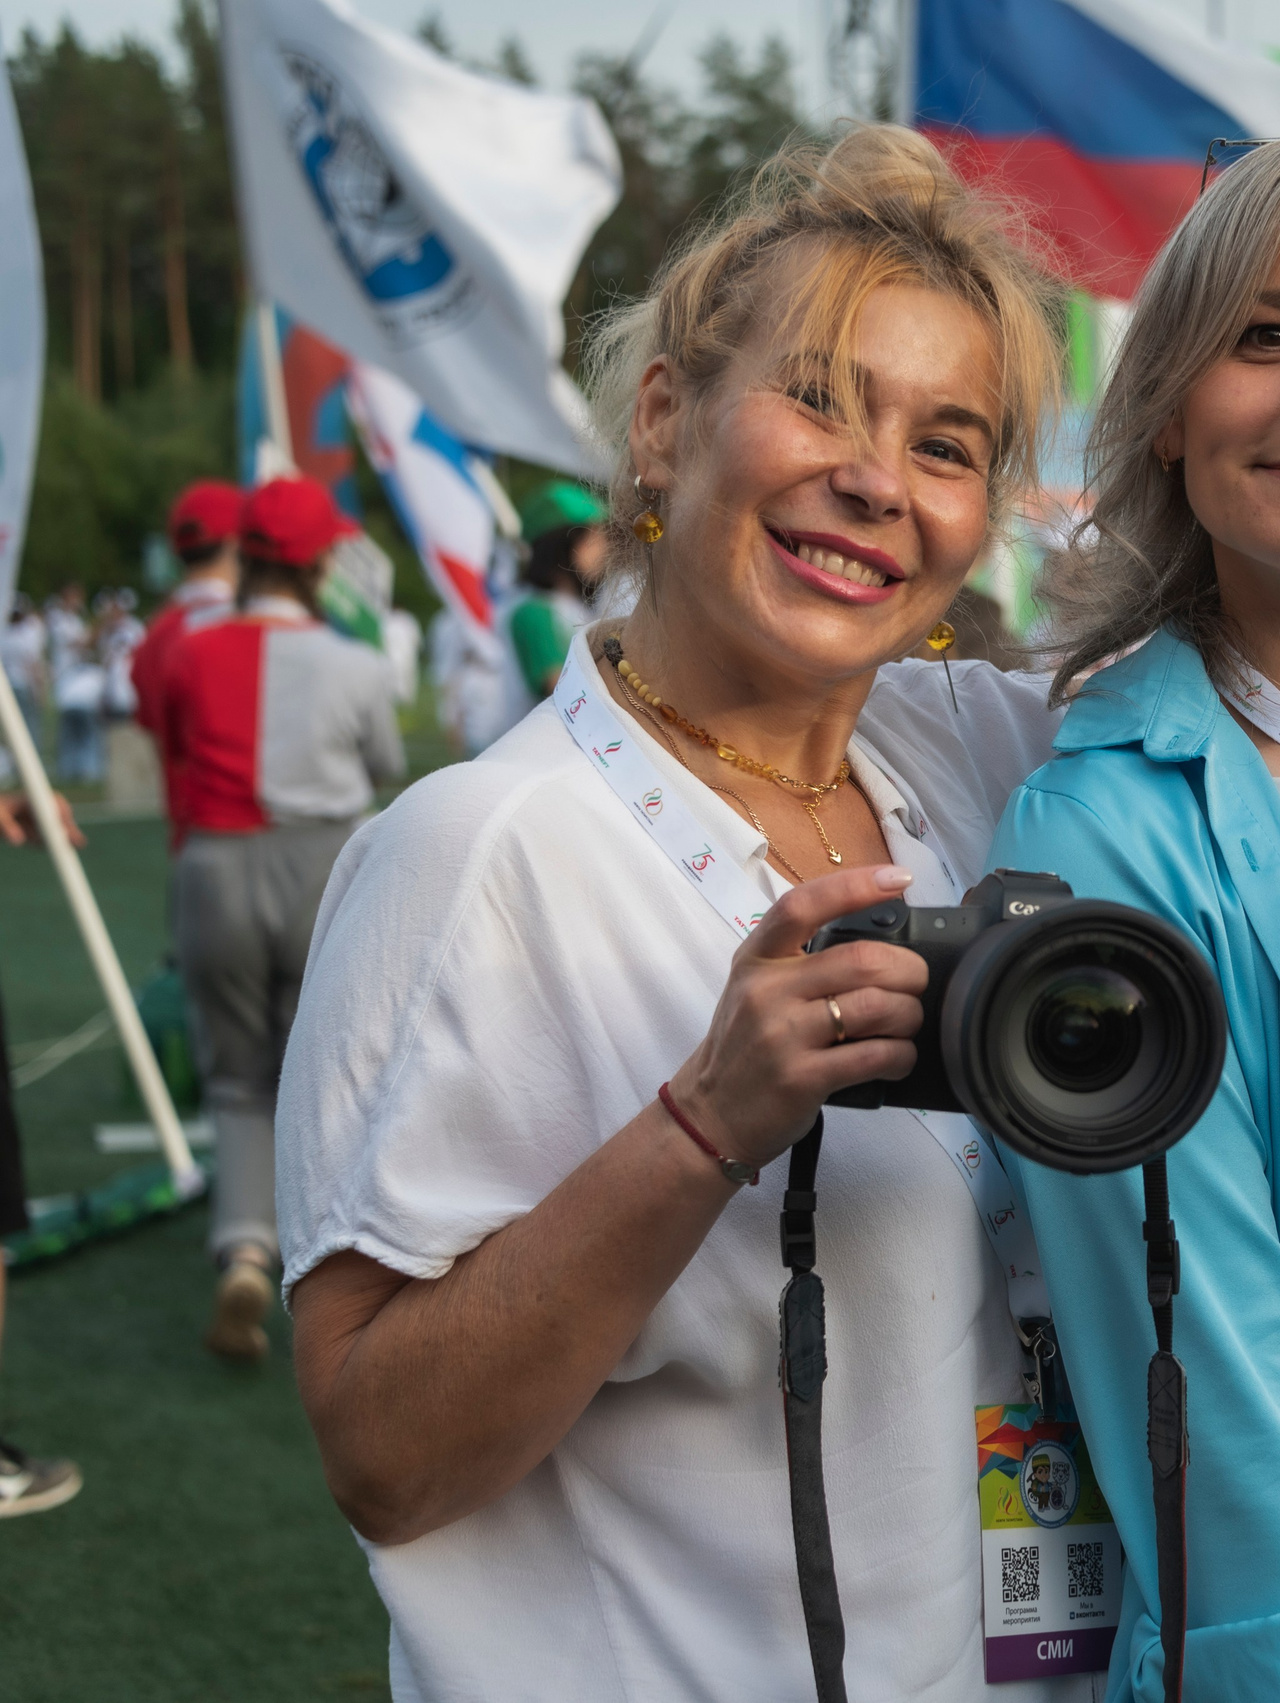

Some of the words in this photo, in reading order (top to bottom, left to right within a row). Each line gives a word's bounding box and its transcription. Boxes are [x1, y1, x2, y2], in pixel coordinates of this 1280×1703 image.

[591, 746, 610, 769] TATNEFT
[1005, 1606, 1038, 1617] Программа
[1080, 1602, 1089, 1610] Мы
[1002, 1615, 1041, 1627] мероприятия
[1036, 1638, 1074, 1661] СМИ
